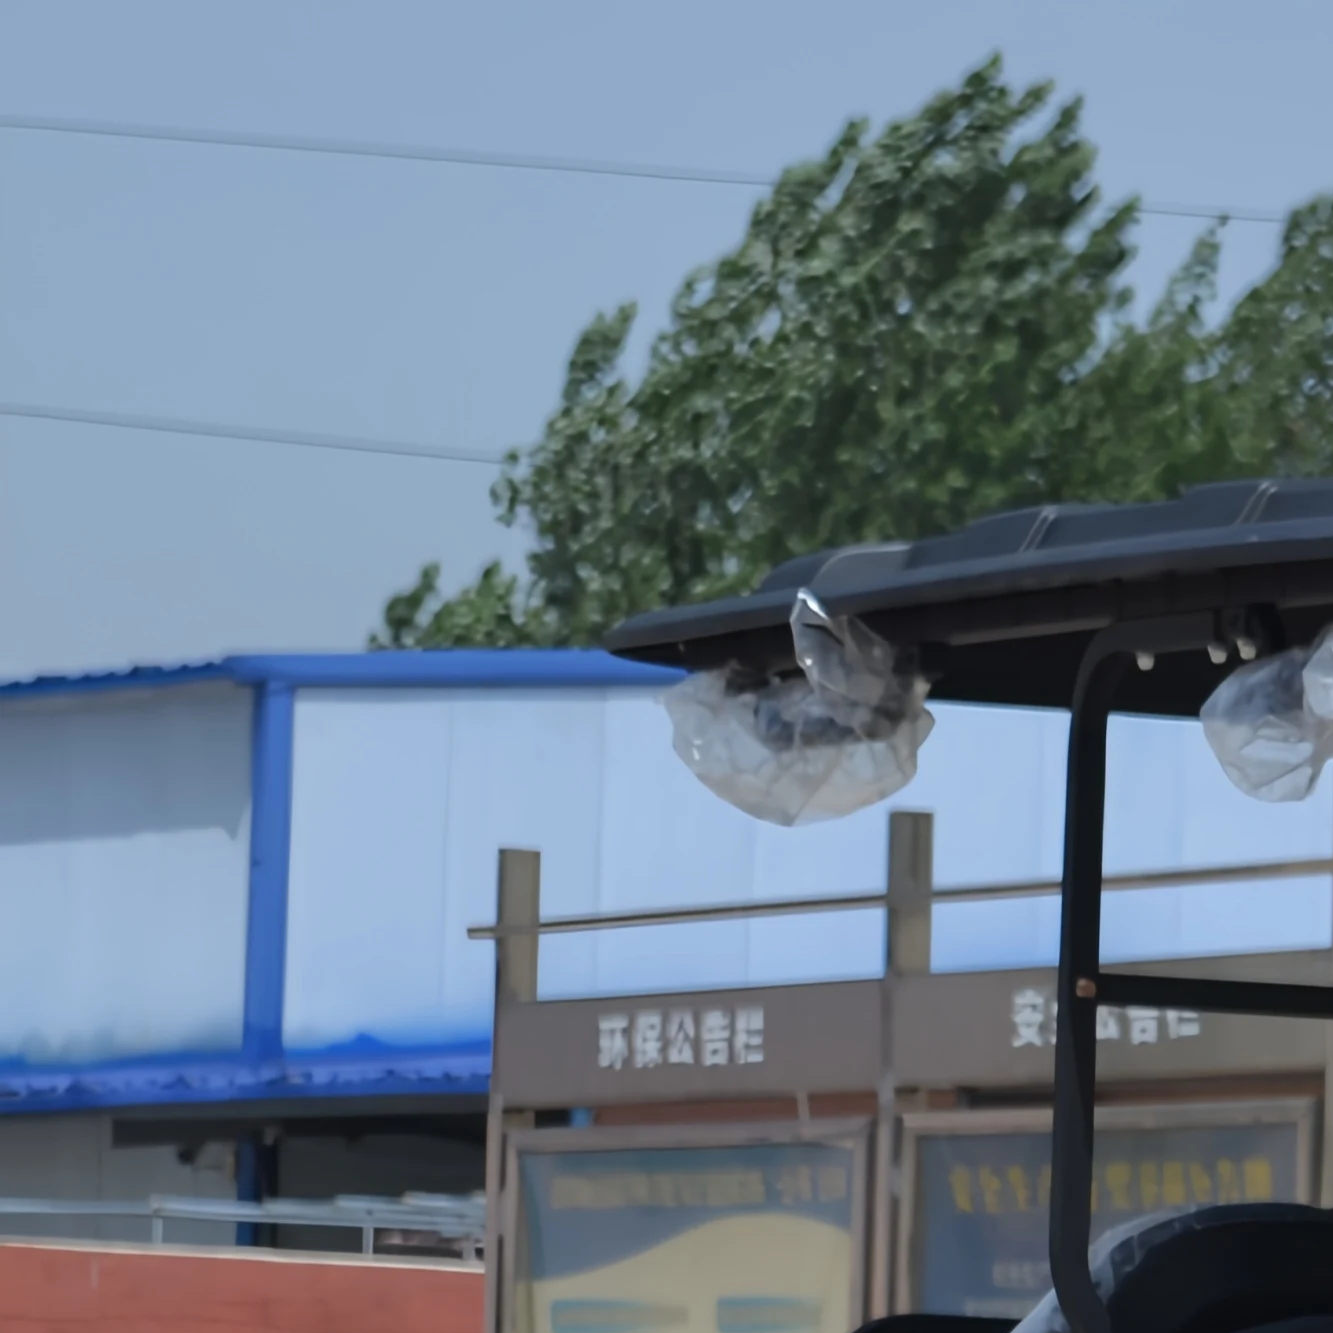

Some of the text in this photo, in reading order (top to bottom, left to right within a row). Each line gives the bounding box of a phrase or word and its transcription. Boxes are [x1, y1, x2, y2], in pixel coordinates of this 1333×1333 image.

[597, 1004, 765, 1071] 环保公告栏
